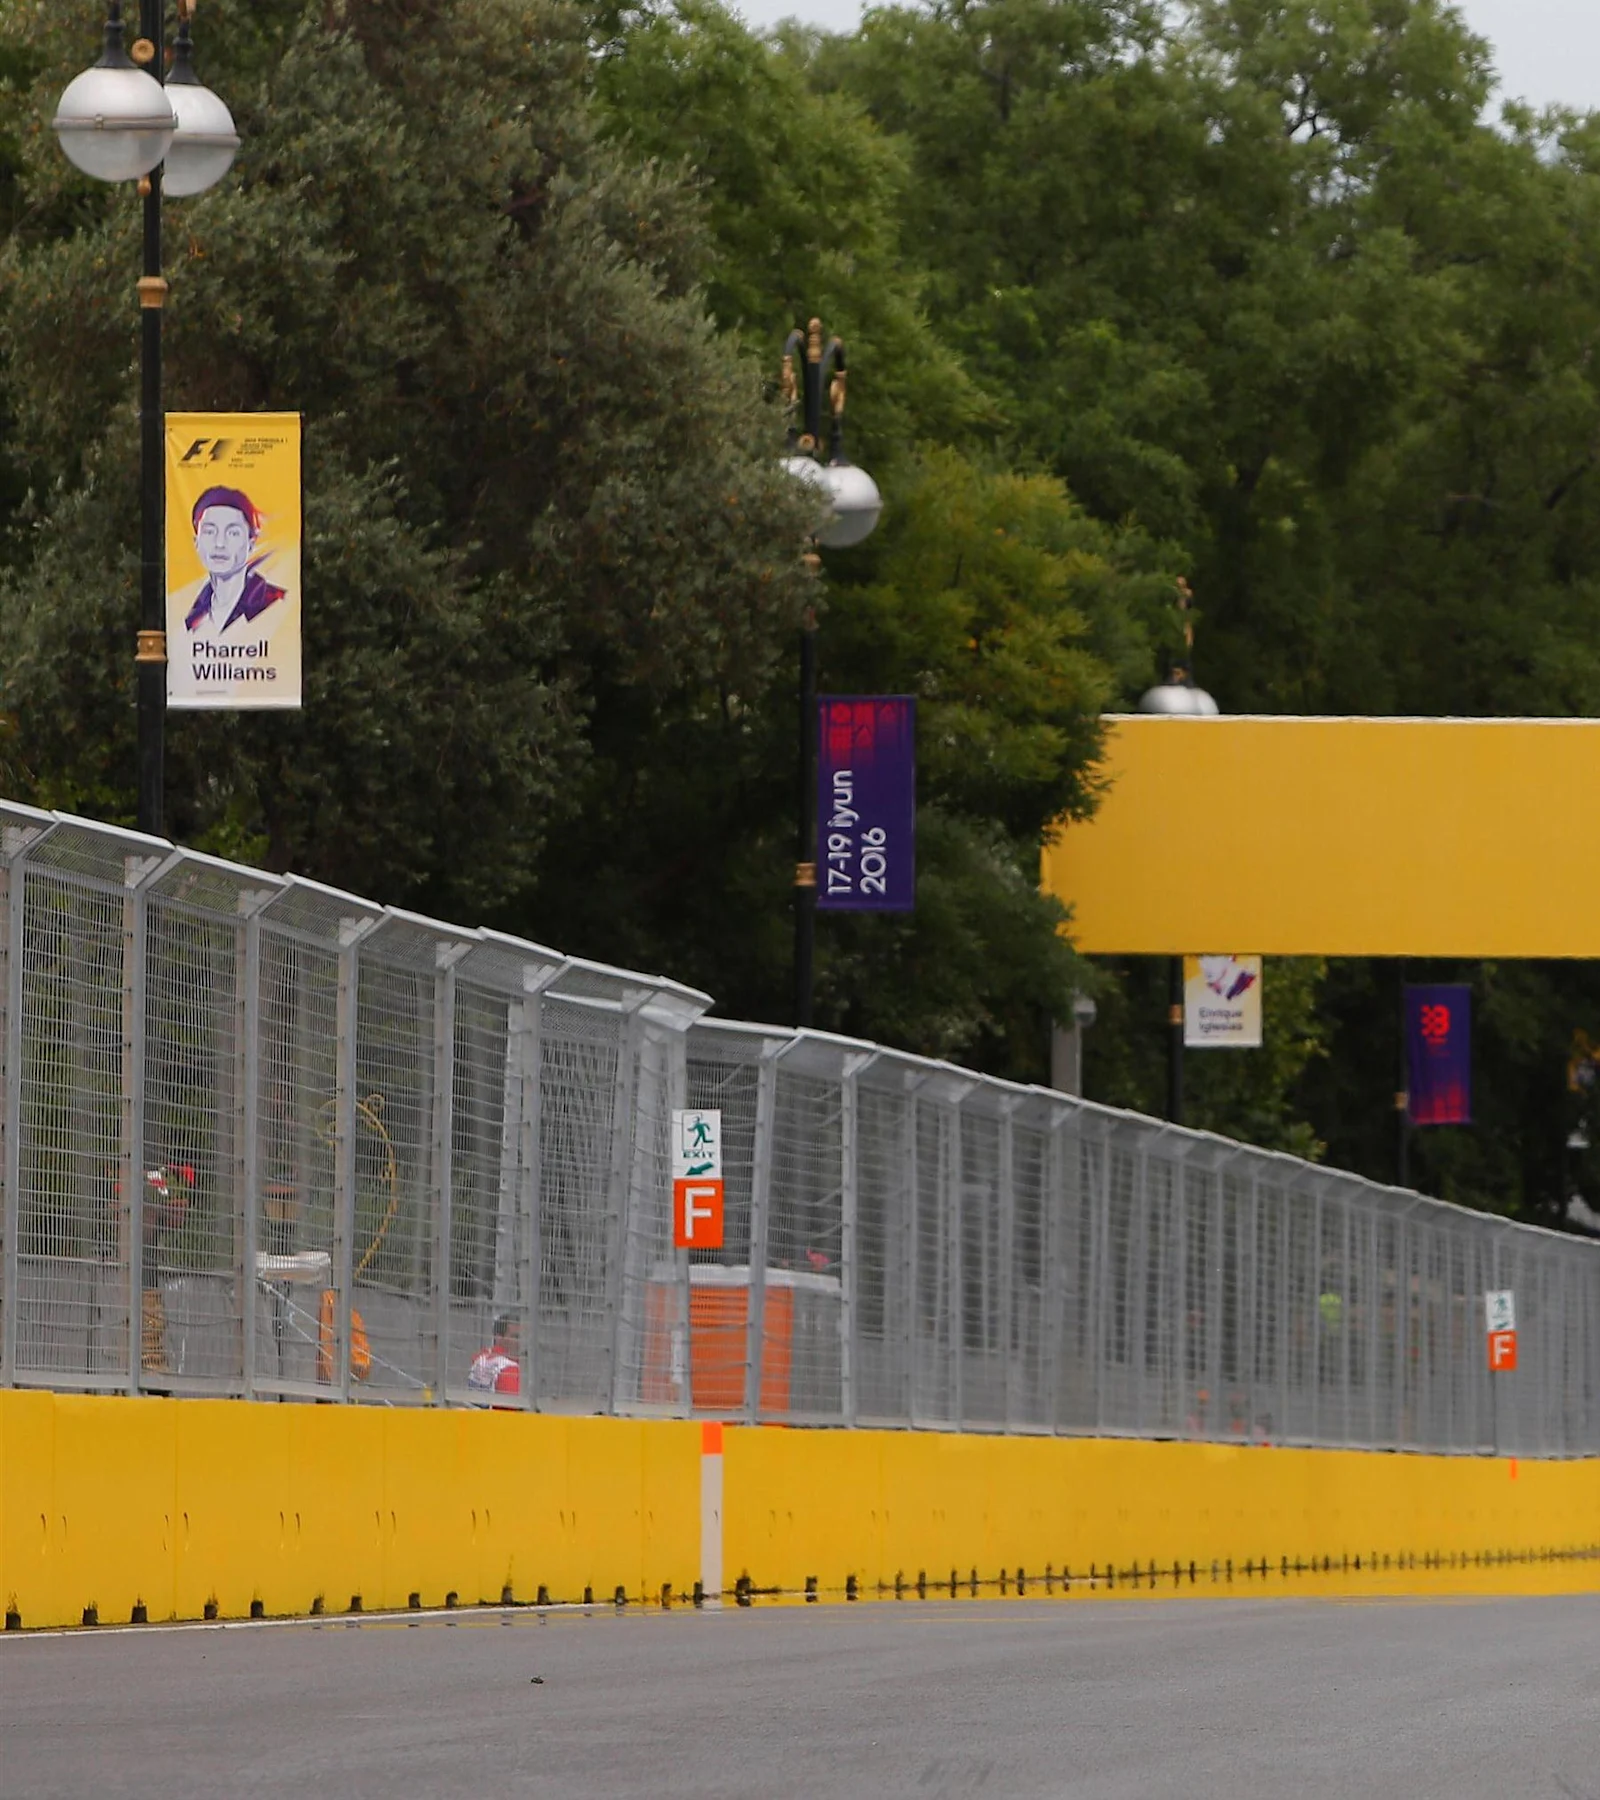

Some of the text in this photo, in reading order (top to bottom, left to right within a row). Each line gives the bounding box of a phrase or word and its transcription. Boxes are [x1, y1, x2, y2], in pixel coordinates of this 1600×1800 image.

[193, 640, 268, 658] Pharrell
[192, 662, 277, 680] Williams
[827, 770, 860, 895] 17-19 iyun
[860, 827, 886, 895] 2016
[682, 1151, 715, 1159] EXIT
[684, 1187, 716, 1239] F
[1494, 1334, 1514, 1366] F
